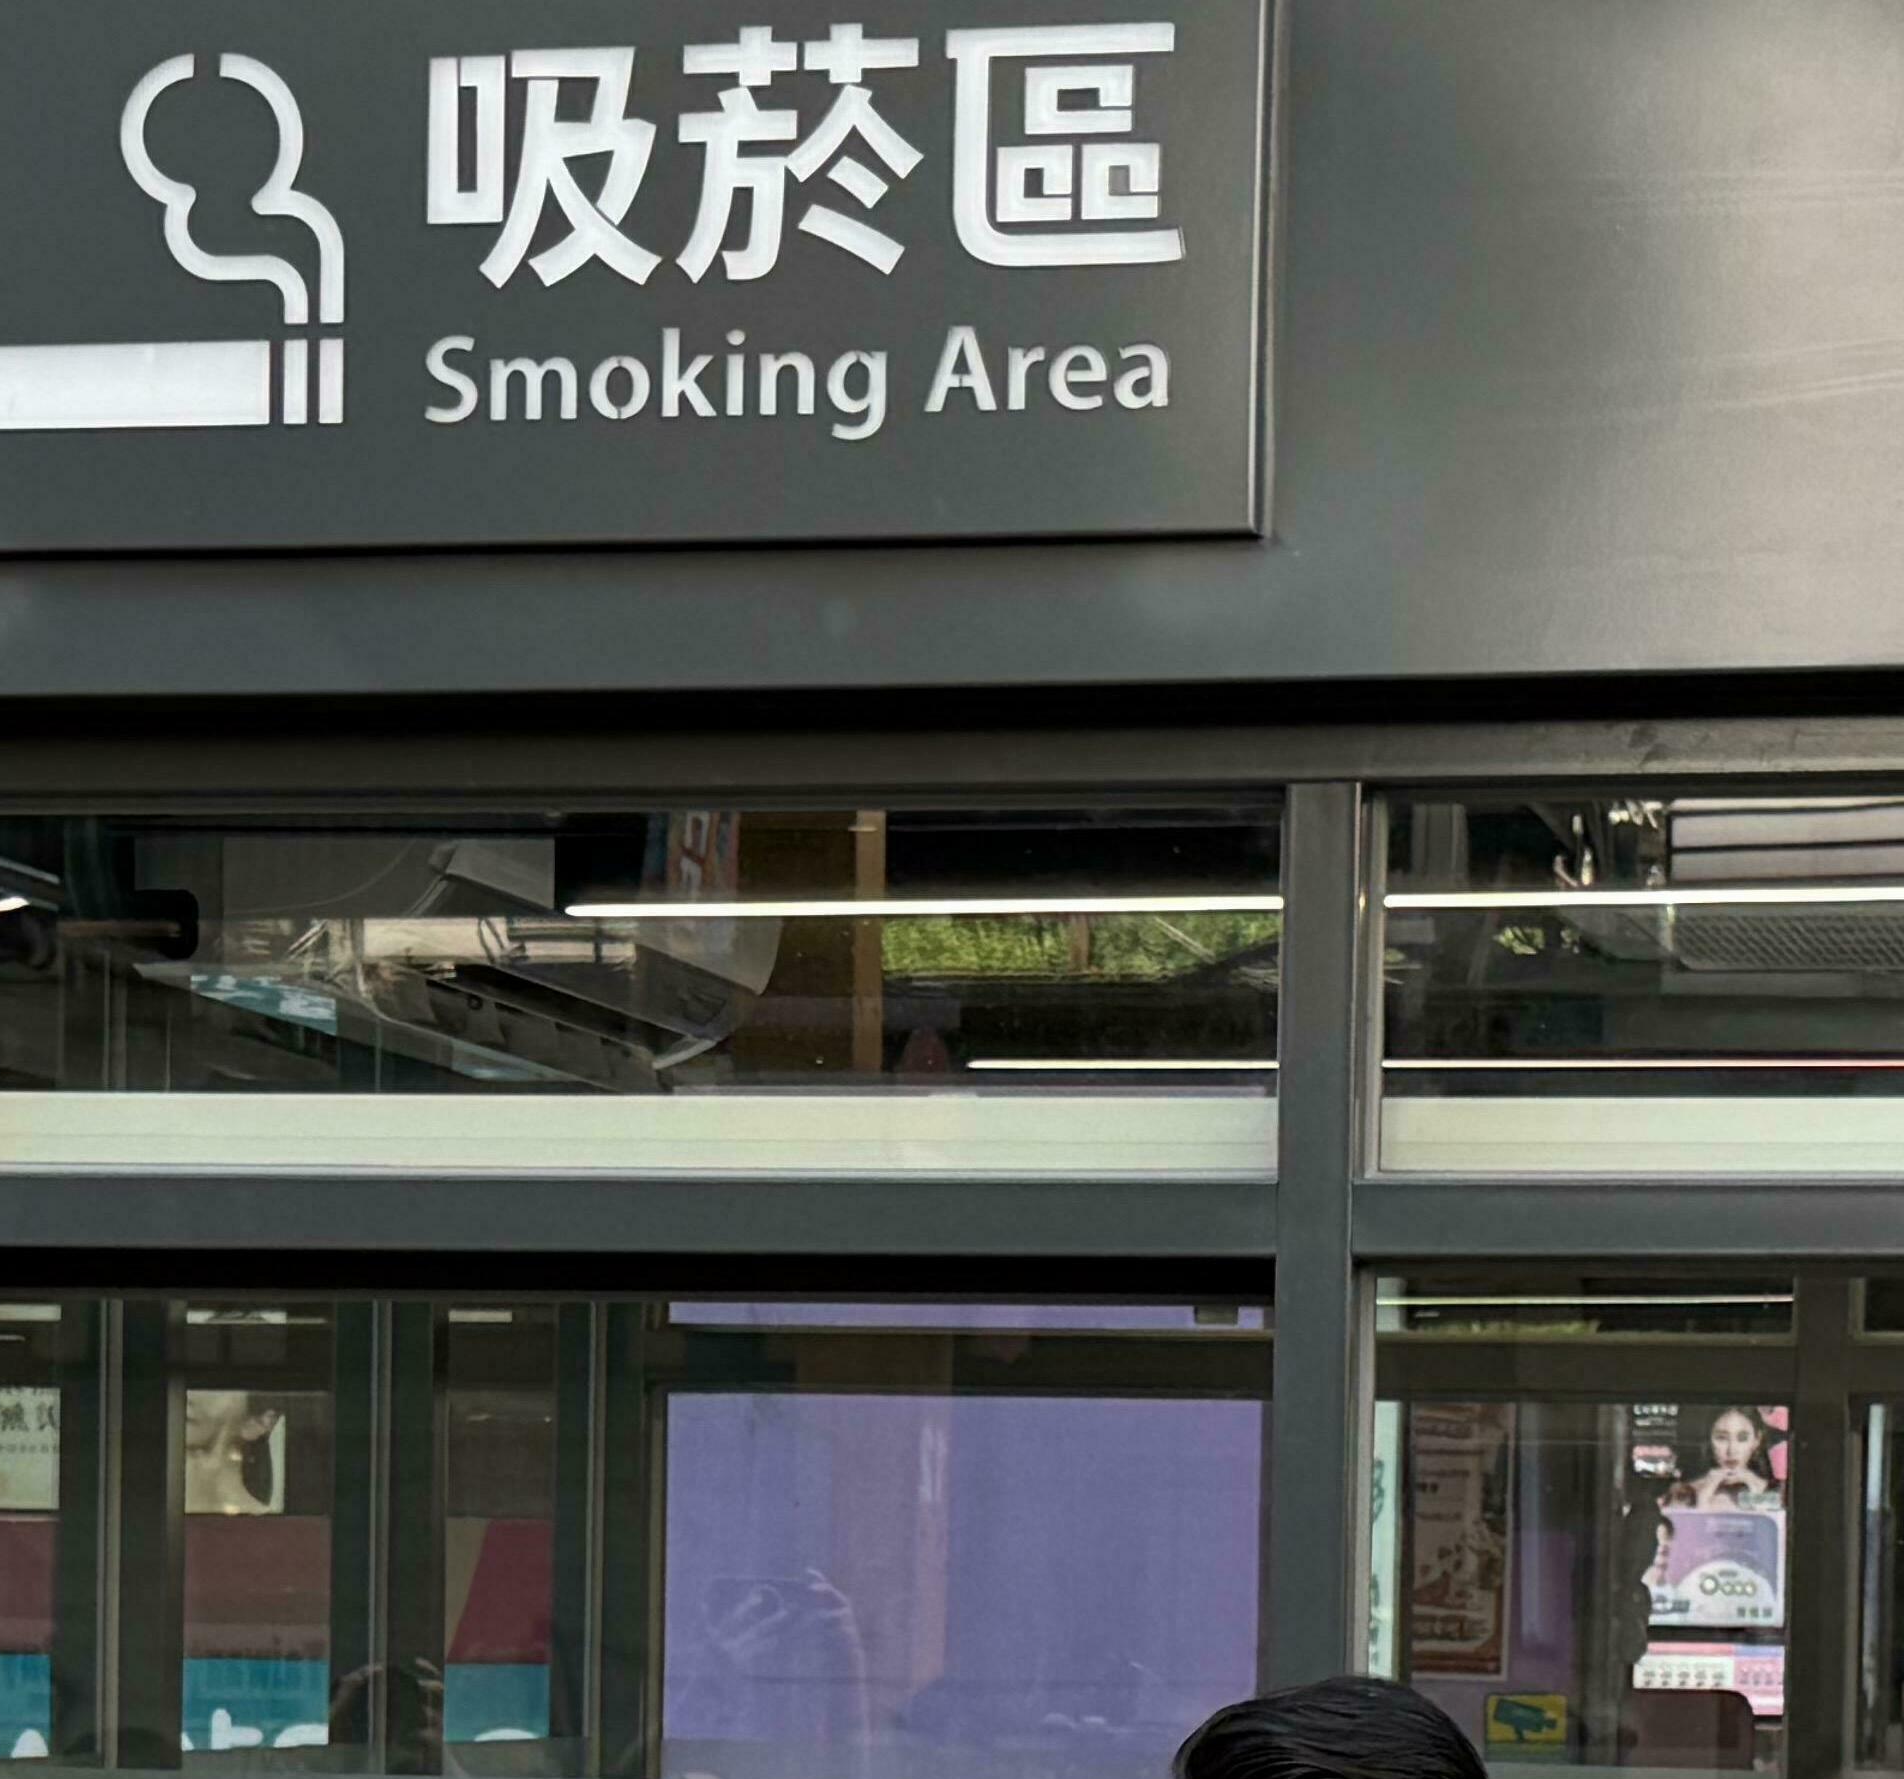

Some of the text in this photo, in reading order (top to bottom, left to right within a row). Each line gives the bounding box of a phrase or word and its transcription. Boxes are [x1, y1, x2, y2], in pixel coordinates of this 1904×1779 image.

[426, 22, 1186, 288] 吸菸區
[424, 326, 1172, 440] Smoking Area
